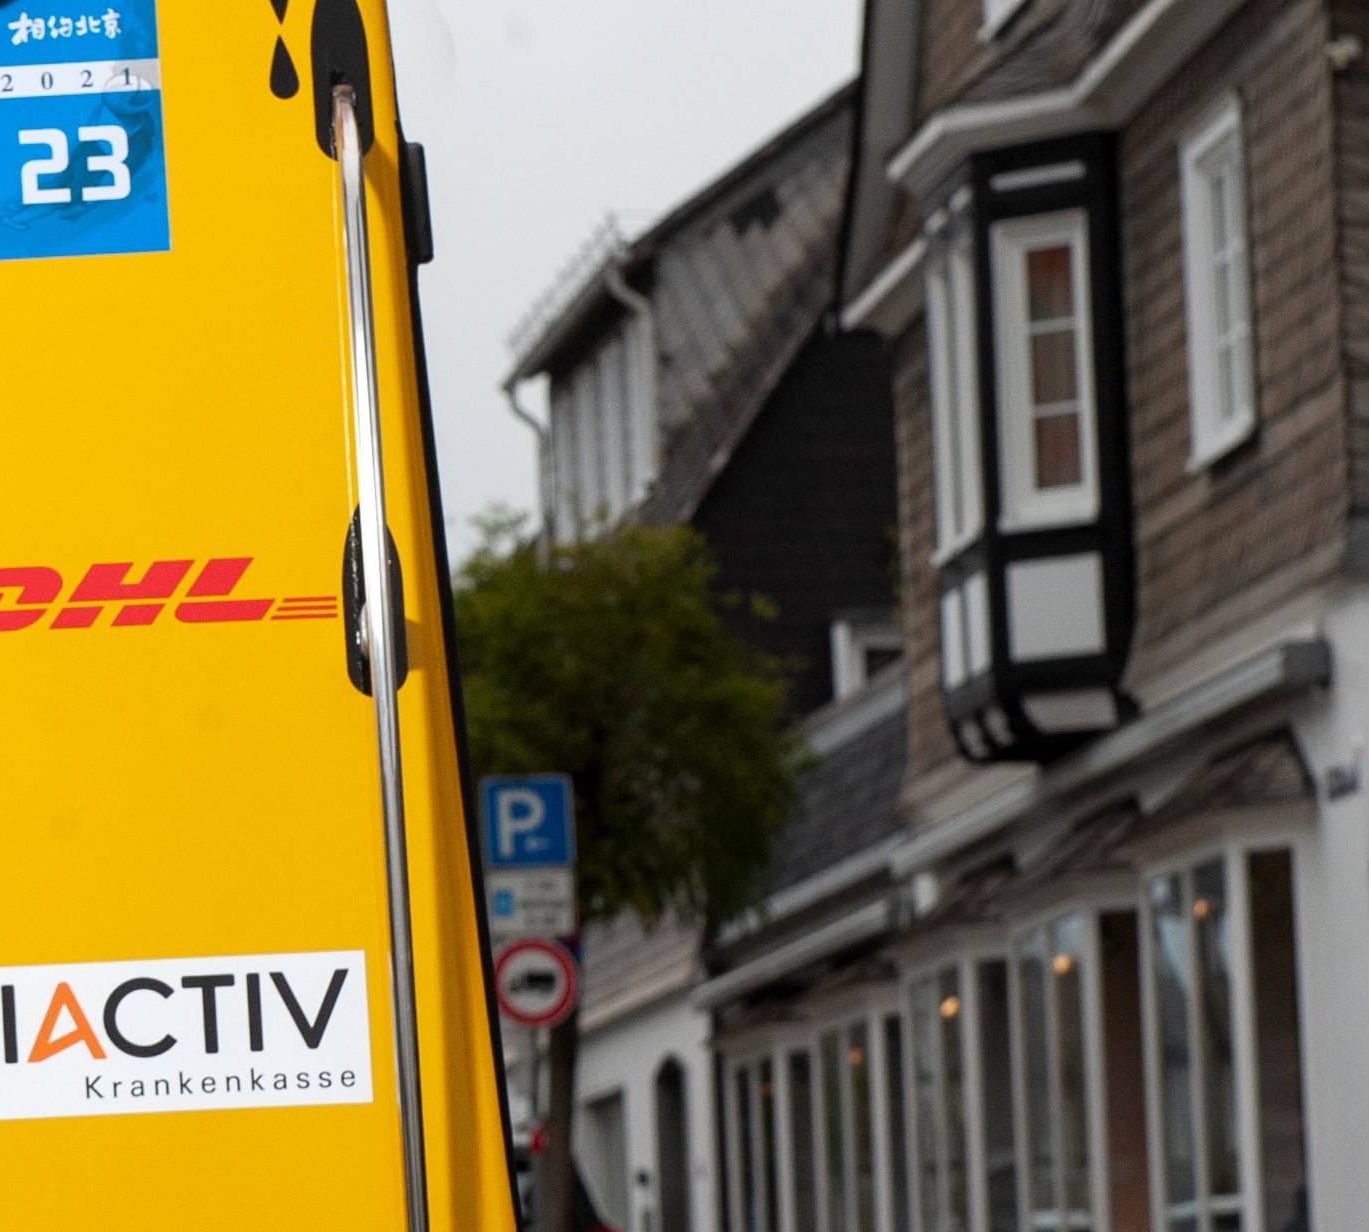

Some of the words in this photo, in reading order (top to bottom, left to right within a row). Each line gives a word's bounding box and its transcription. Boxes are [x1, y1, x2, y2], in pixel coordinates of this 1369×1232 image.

[18, 125, 131, 205] 23
[496, 788, 545, 859] P
[85, 1068, 357, 1100] Krankenkasse
